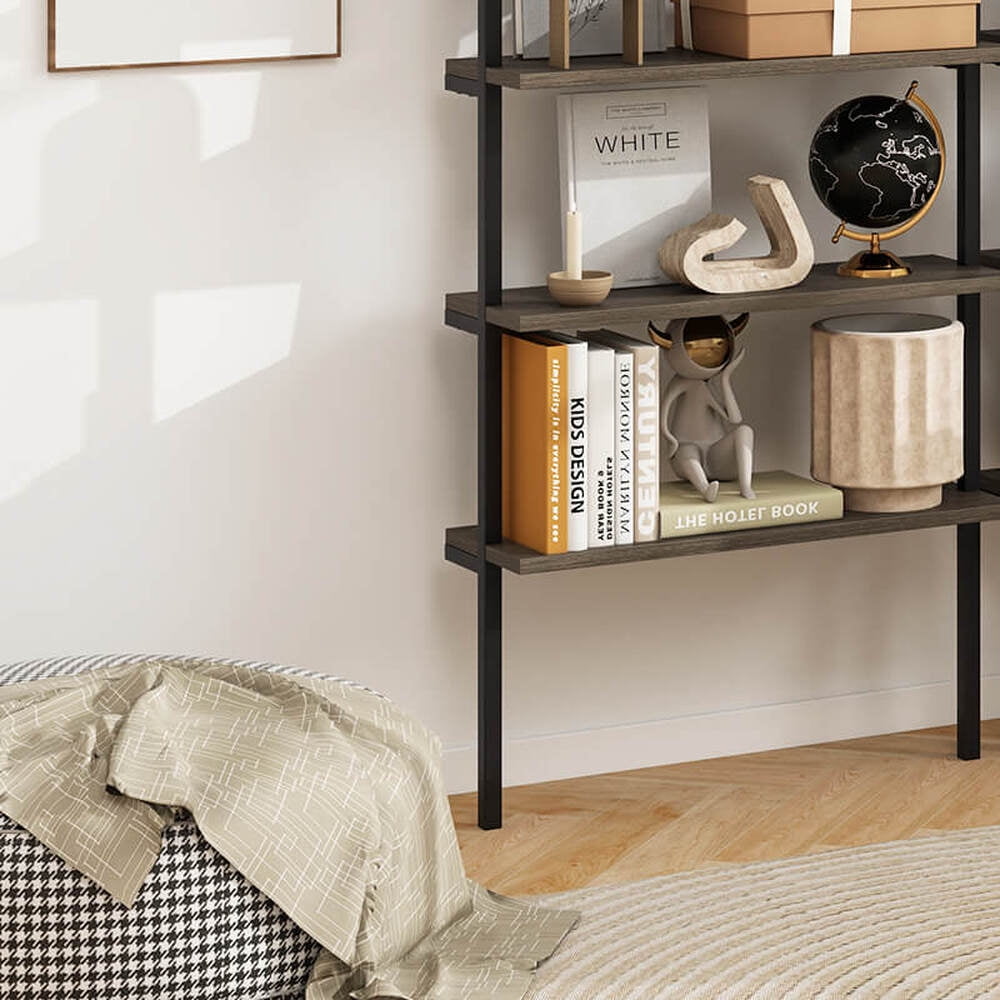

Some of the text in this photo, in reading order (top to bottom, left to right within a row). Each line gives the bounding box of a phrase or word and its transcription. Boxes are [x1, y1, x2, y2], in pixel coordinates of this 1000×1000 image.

[594, 131, 680, 153] WHITE
[550, 359, 560, 414] simplicity
[552, 417, 560, 427] is
[552, 430, 560, 441] in
[551, 445, 560, 503] everything
[571, 397, 584, 513] KIDS DESIGN
